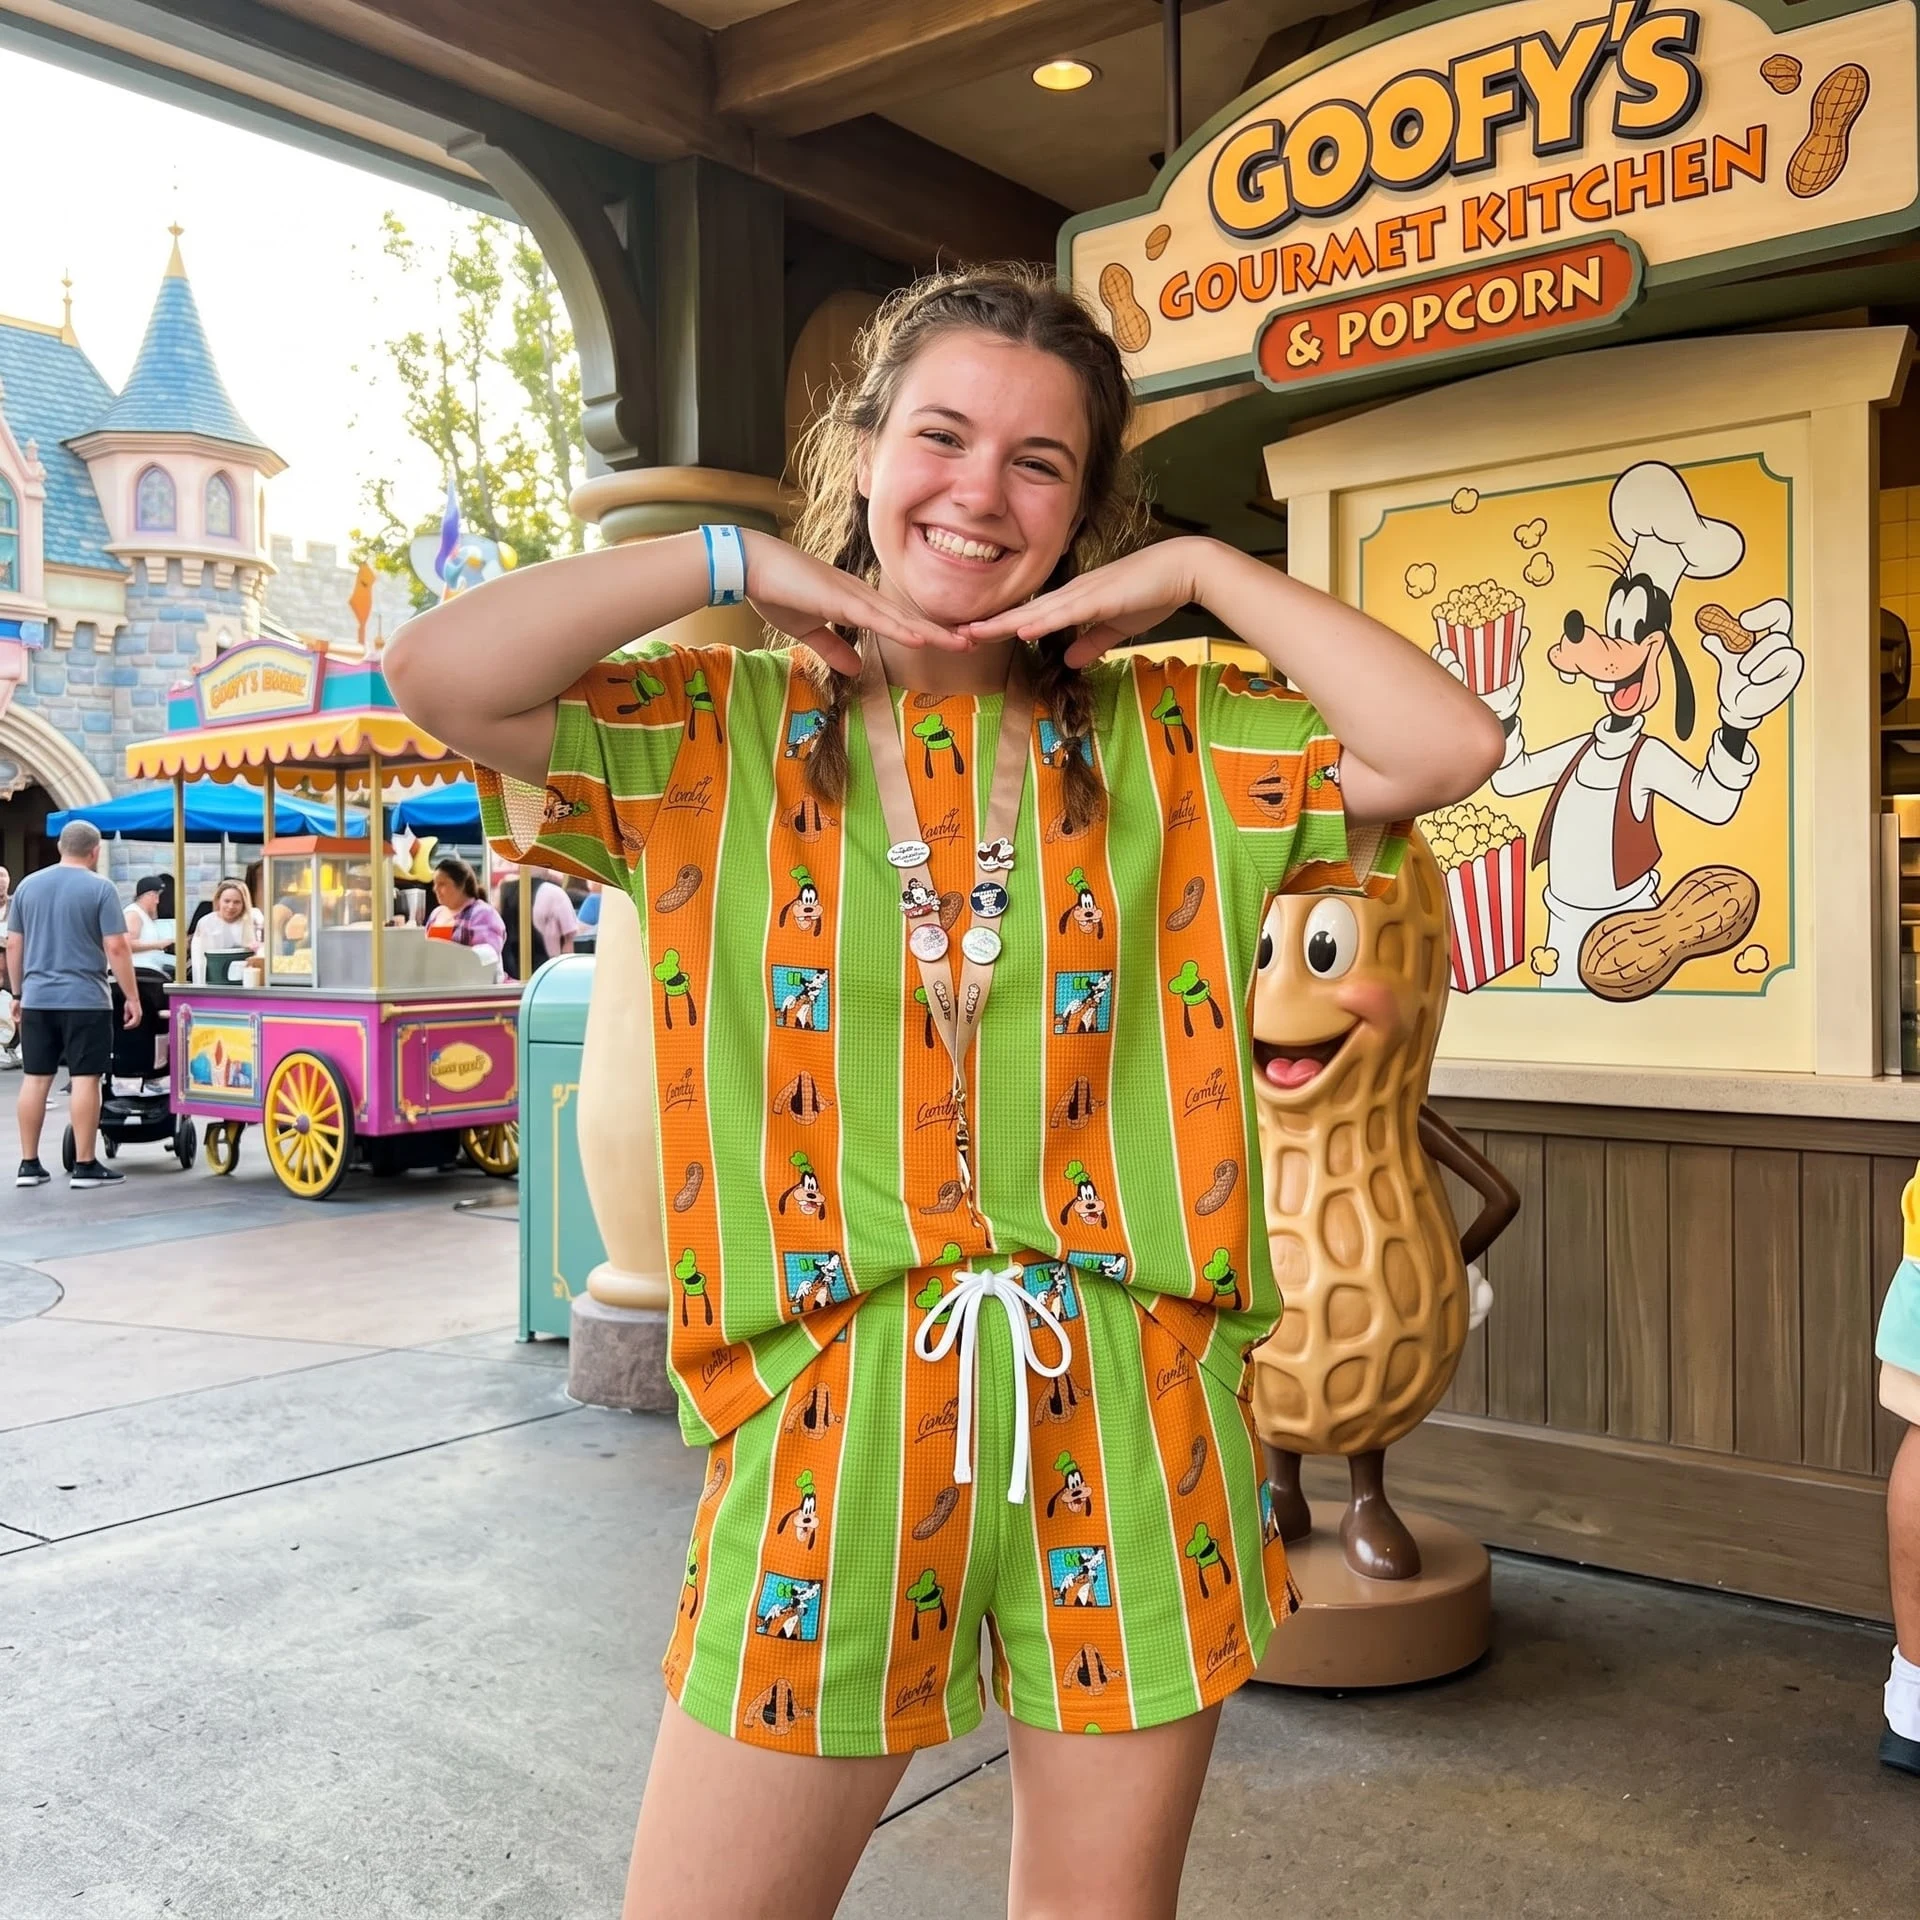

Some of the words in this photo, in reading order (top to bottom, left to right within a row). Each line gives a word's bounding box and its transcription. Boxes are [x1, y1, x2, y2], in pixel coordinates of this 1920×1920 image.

[1208, 0, 1702, 240] GOOFY'S
[1159, 207, 1446, 320] GOURMET
[1461, 124, 1768, 252] KITCHEN
[1285, 320, 1322, 367] &
[1337, 257, 1602, 357] POPCORN
